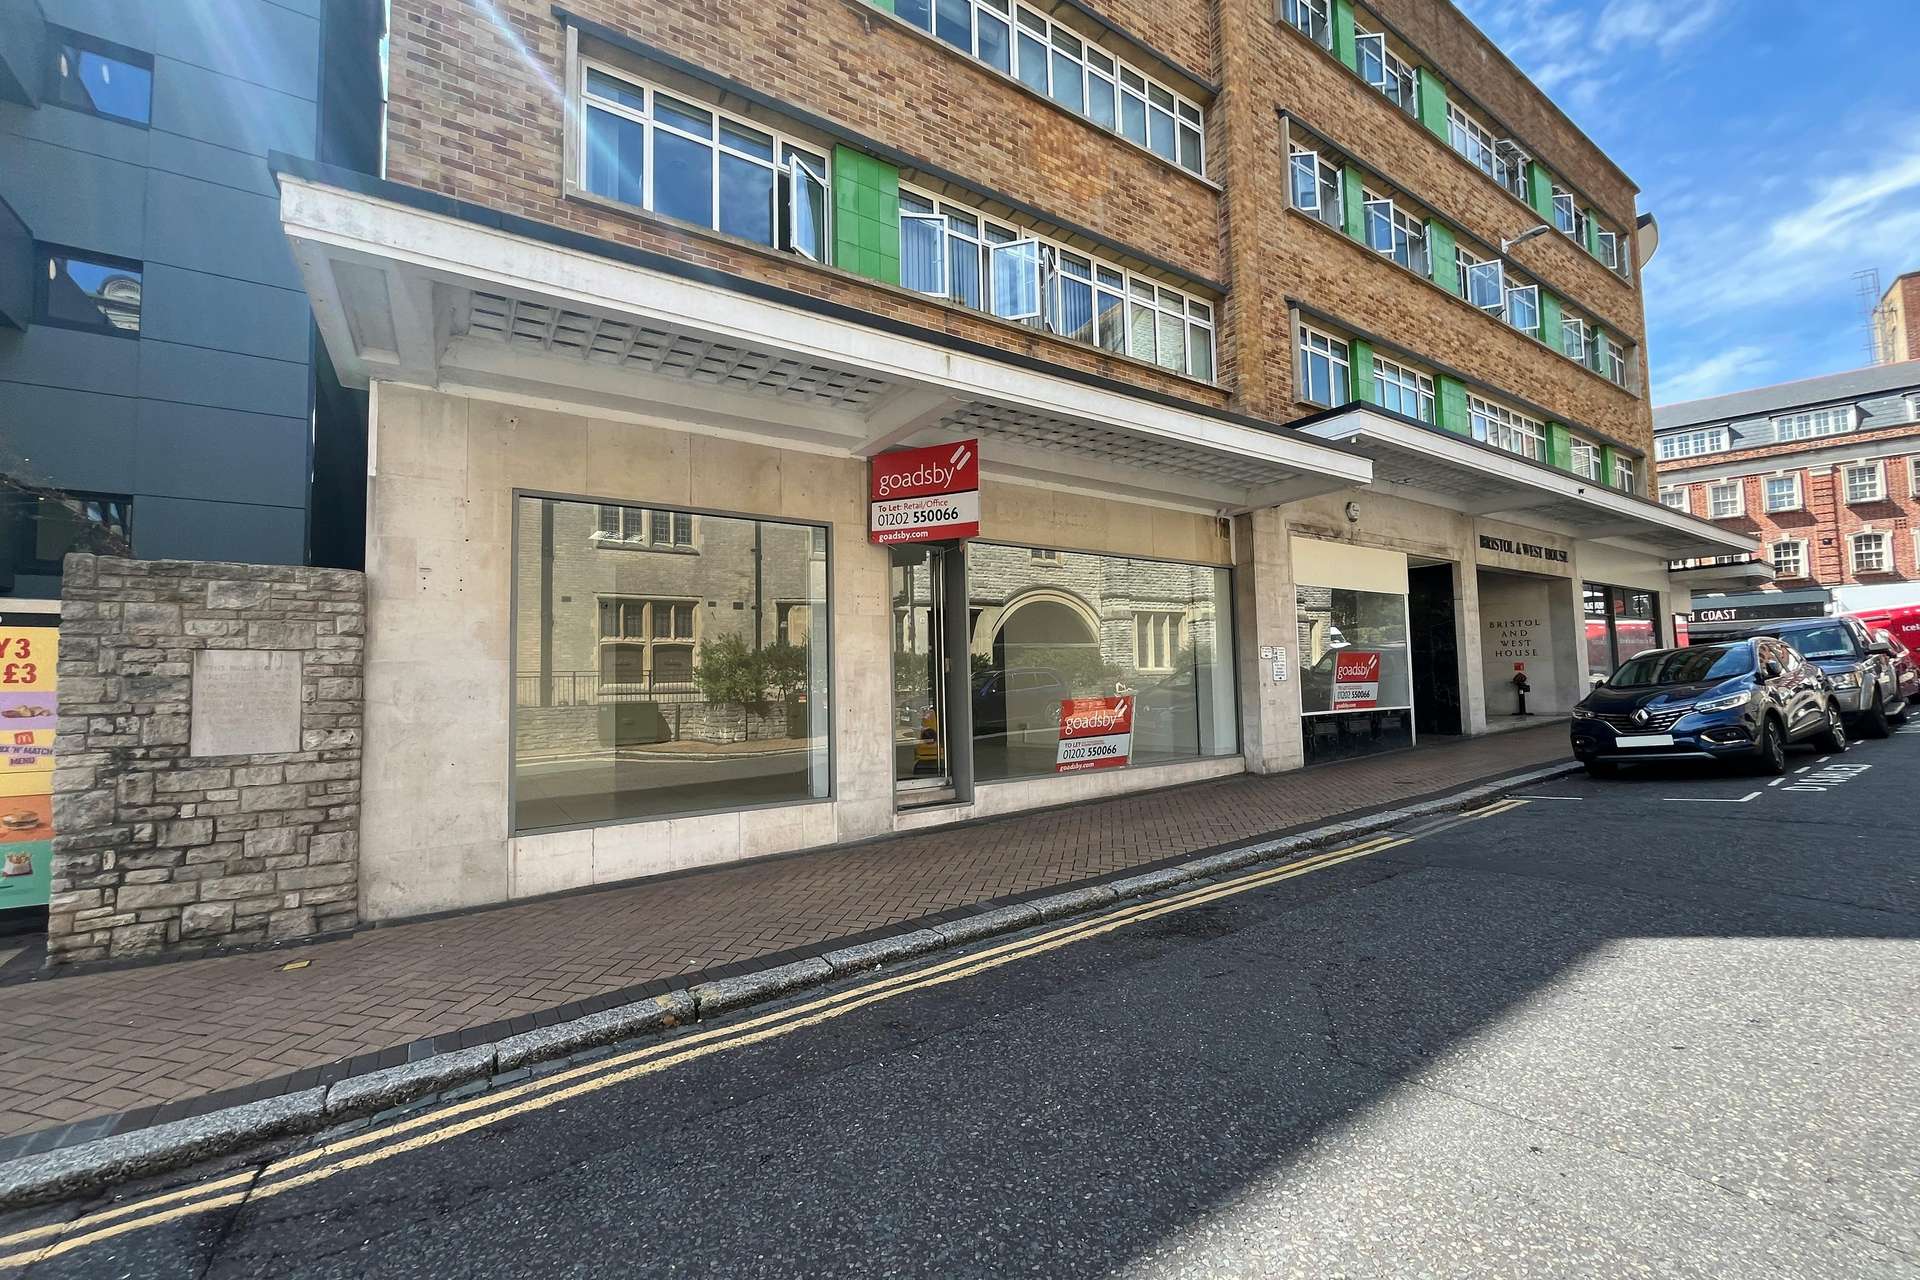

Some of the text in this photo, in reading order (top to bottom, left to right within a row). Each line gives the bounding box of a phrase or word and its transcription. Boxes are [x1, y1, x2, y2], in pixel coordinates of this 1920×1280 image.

[879, 462, 954, 496] goadsby
[878, 505, 887, 513] To
[903, 499, 949, 511] Retail/Office
[877, 506, 959, 527] 01202 550066
[878, 530, 929, 543] goadsby.com
[1479, 534, 1515, 554] BRISTOL
[1521, 543, 1543, 559] WEST
[1544, 547, 1569, 563] HOUSE
[1701, 609, 1737, 621] COAST
[1489, 619, 1541, 629] BRISTOL
[1502, 629, 1528, 638] AND
[14, 638, 31, 659] 3
[1500, 639, 1531, 647] WEST
[1495, 648, 1538, 657] HOUSE
[3, 662, 37, 684] £3
[1337, 662, 1370, 680] goadsby
[1351, 689, 1371, 699] 550066
[1065, 710, 1117, 735] goadsby
[1062, 748, 1086, 760] 01202
[1087, 744, 1117, 757] 550066
